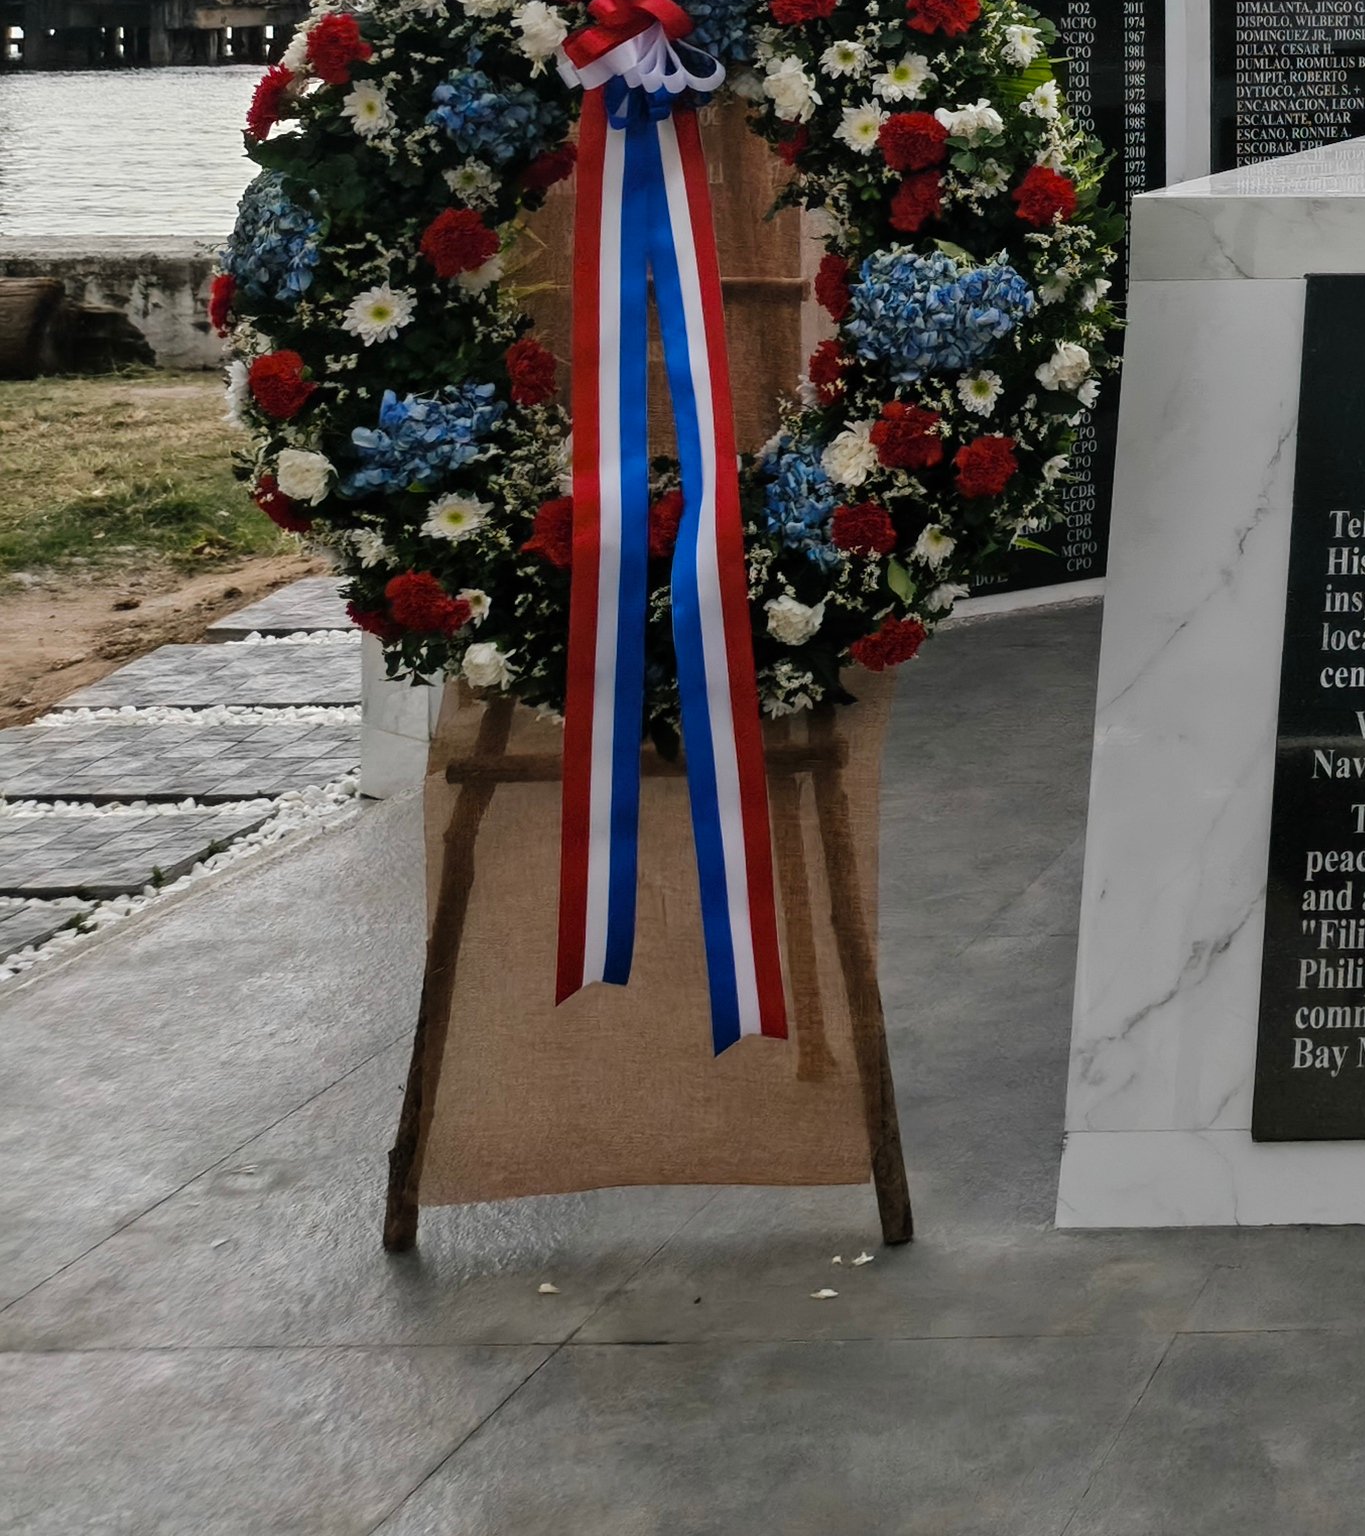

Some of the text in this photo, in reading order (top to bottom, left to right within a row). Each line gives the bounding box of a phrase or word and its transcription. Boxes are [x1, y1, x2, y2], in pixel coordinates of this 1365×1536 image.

[1236, 98, 1330, 112] ENCARNACION,
[1236, 111, 1351, 126] ESCALANTE, OMAR
[1292, 1038, 1349, 1077] Bay
